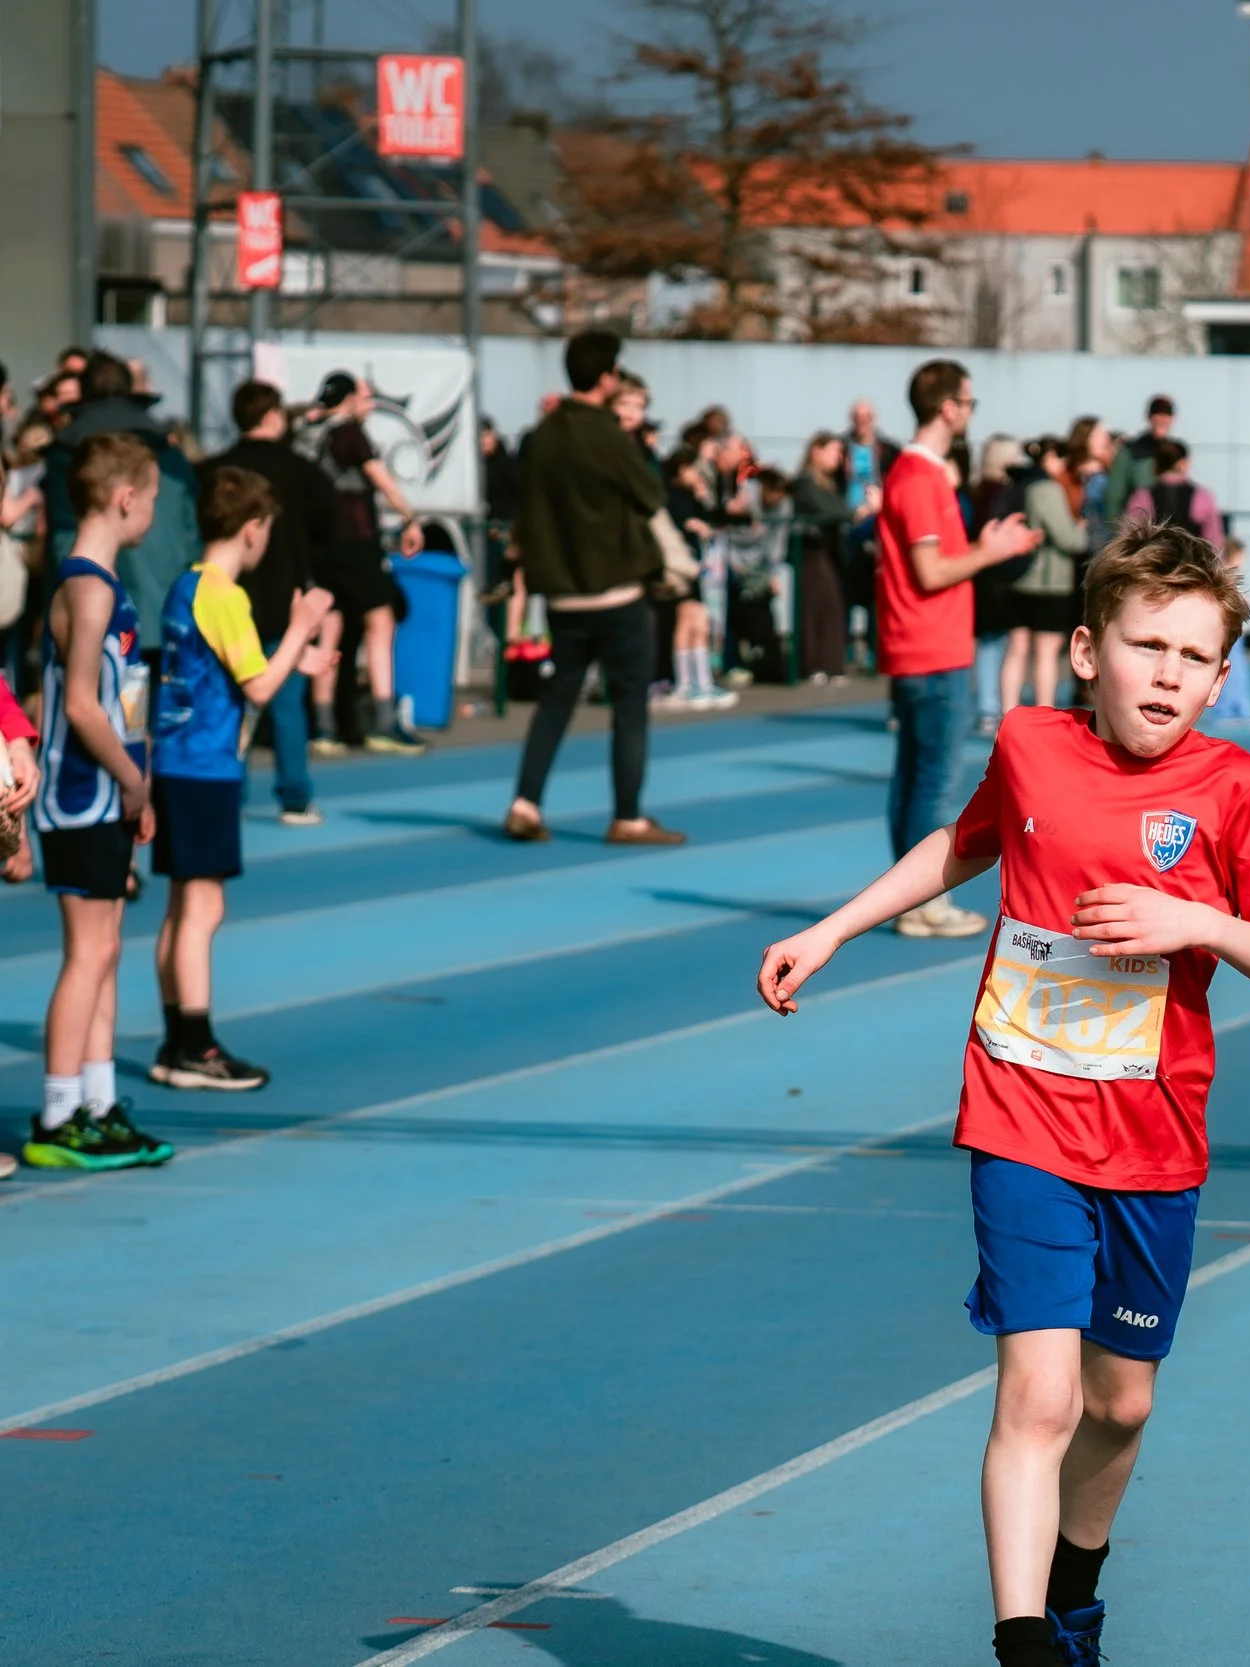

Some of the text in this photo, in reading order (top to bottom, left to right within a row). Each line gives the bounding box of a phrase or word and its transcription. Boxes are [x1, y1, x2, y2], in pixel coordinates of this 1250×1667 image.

[385, 60, 457, 113] WC
[384, 114, 456, 148] TOILET
[1148, 821, 1186, 844] HEDES
[1031, 946, 1046, 961] RUN
[1110, 955, 1159, 975] KIDS
[992, 965, 1150, 1049] 7062
[1112, 1306, 1159, 1328] JAKO
